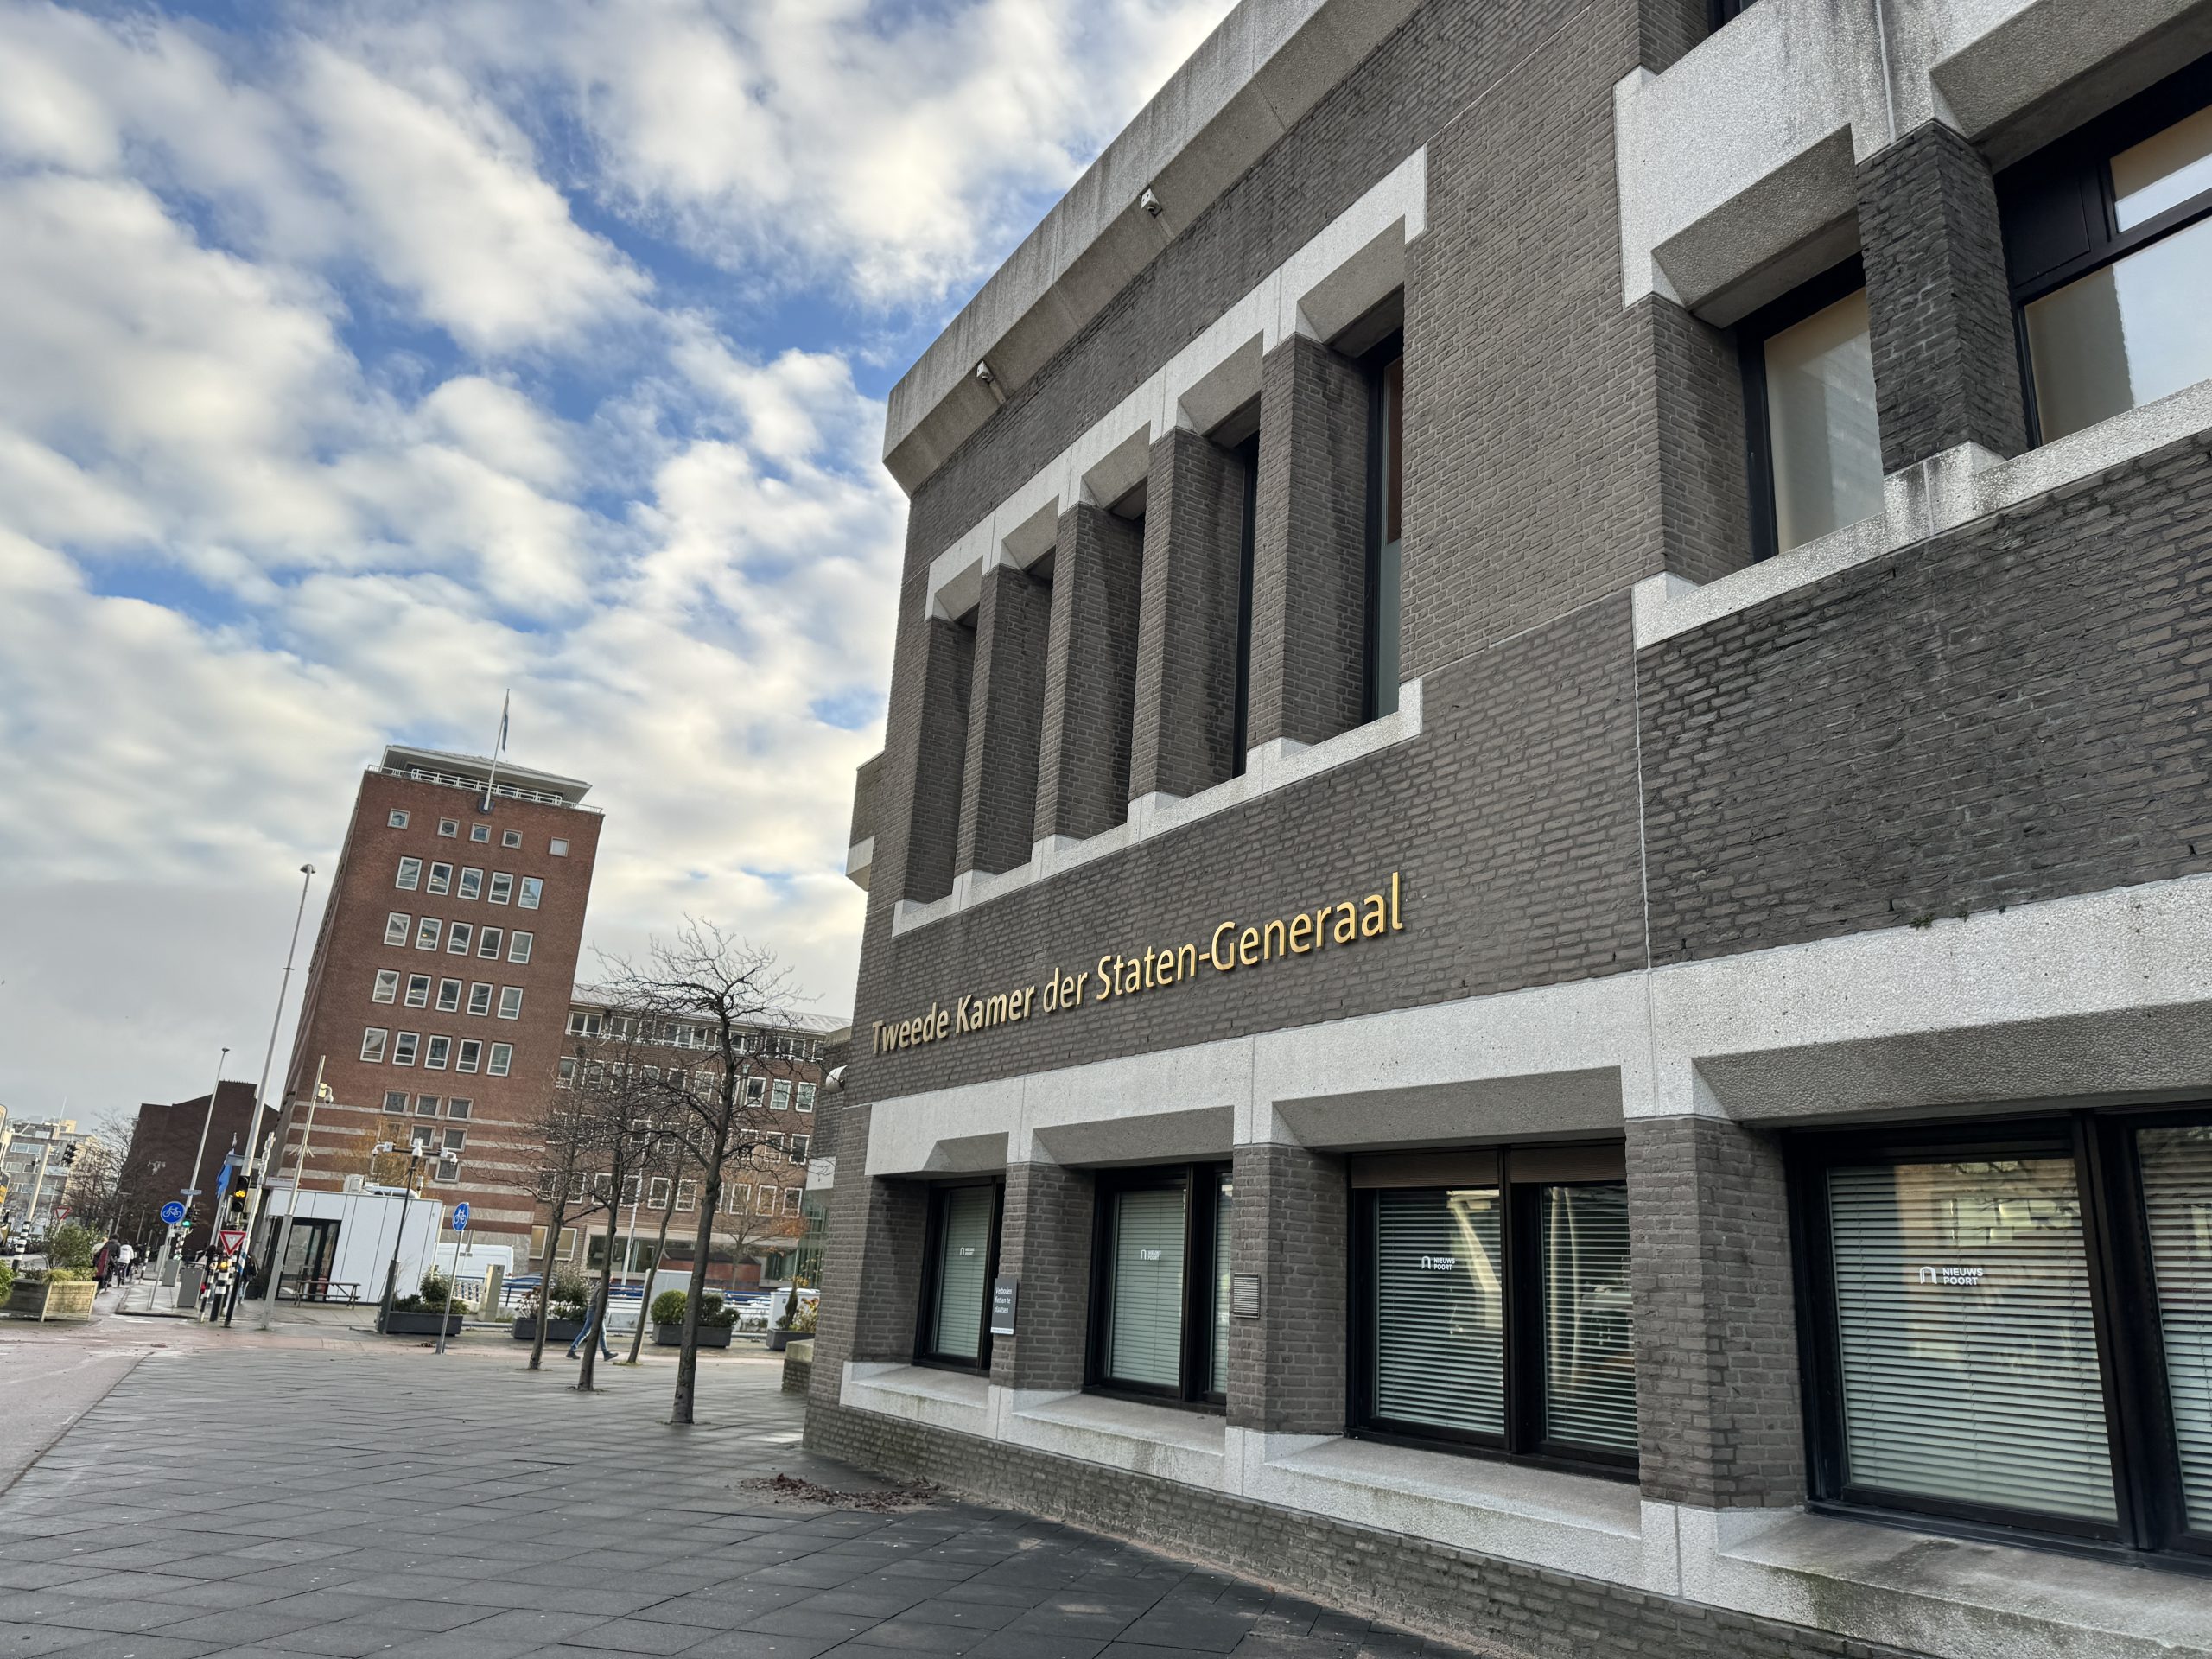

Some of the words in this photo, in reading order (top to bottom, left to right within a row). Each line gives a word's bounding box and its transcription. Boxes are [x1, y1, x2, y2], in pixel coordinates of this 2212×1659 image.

[872, 1002, 950, 1054] Tweede
[956, 986, 1035, 1033] Kamer
[1043, 967, 1088, 1013] der
[1096, 872, 1402, 1000] Staten-Generaal
[1942, 1268, 1984, 1276] NIEUWS
[1943, 1276, 1979, 1285] POORT
